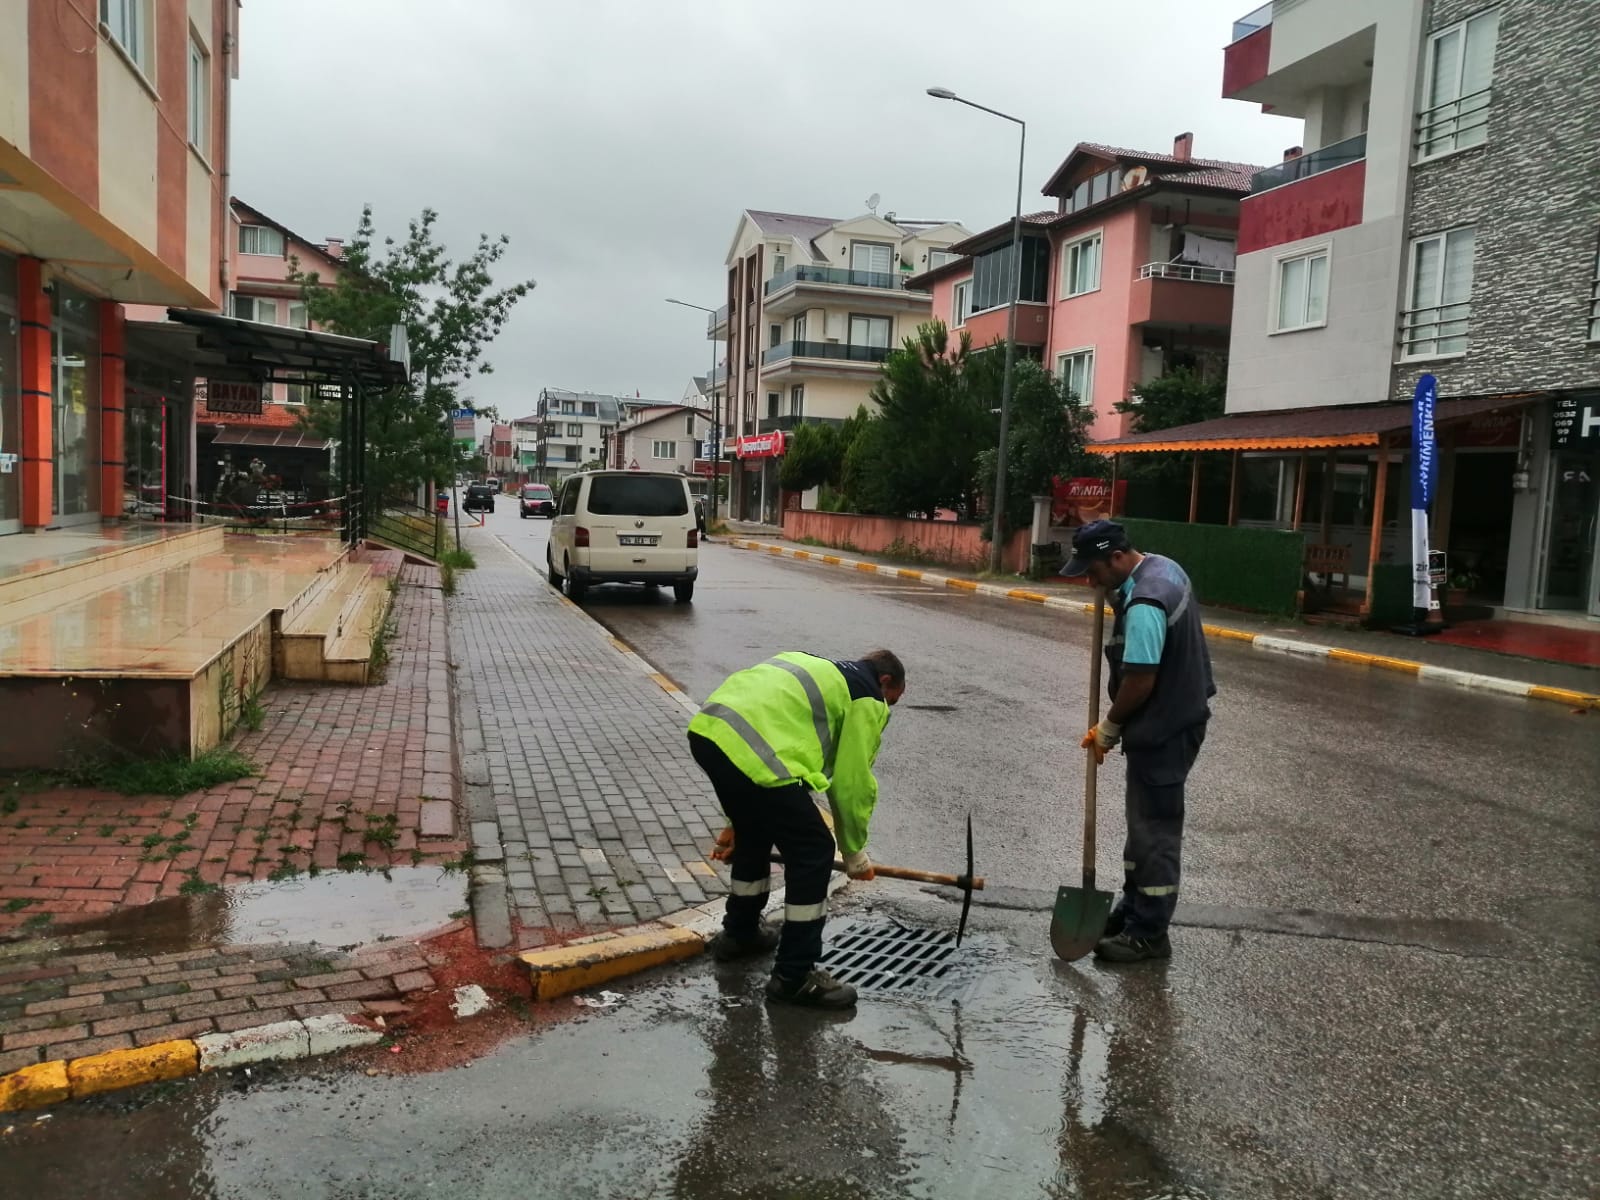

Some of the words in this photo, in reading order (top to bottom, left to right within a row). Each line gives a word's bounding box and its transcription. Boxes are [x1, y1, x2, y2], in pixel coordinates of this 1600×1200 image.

[1557, 399, 1577, 408] TEL:
[1553, 410, 1577, 418] 0532
[1555, 419, 1573, 427] 069
